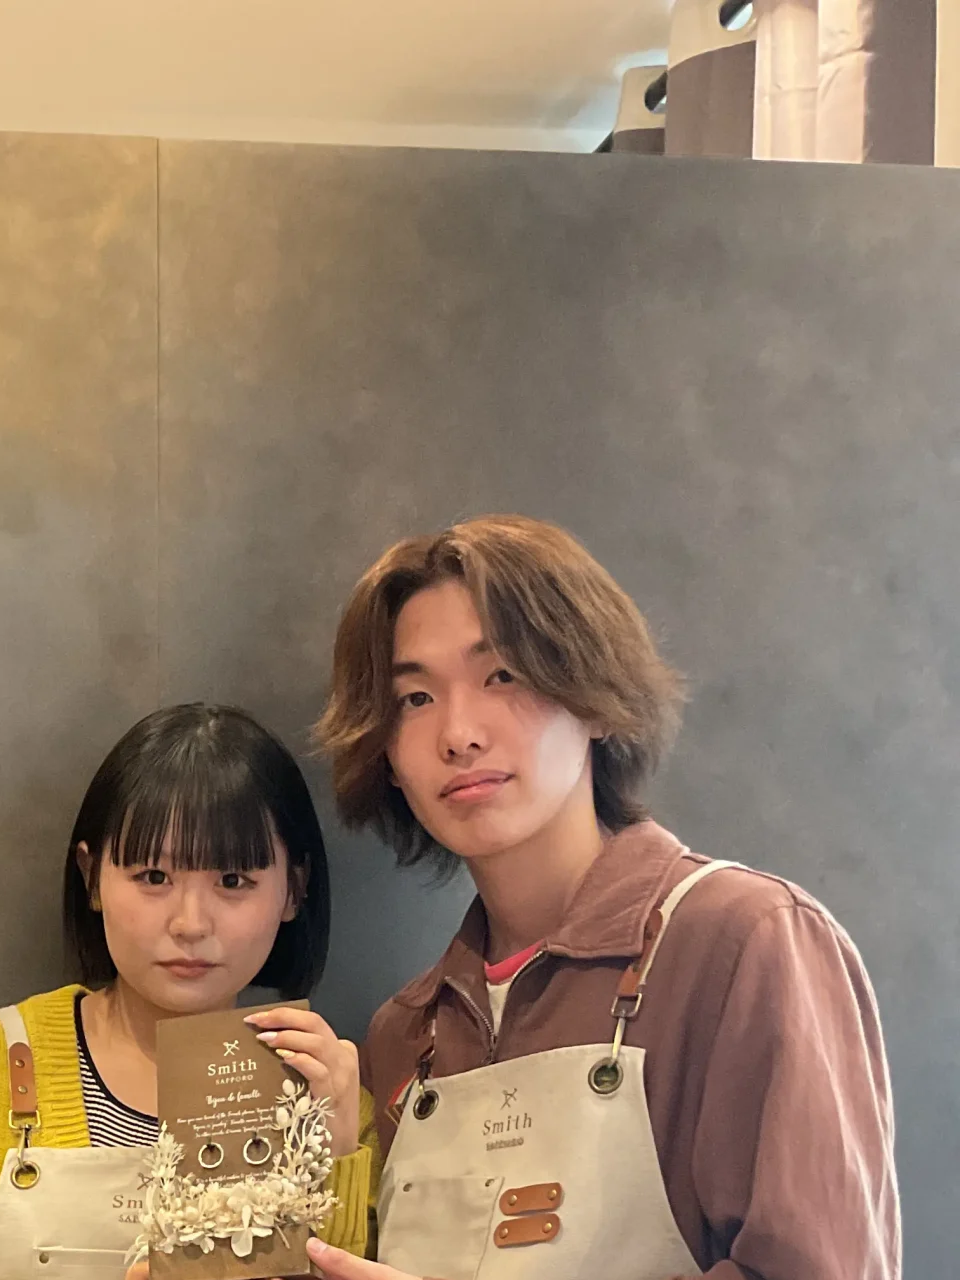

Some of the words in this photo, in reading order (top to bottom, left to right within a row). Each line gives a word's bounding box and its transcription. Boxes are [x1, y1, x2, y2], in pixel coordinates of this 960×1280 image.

[207, 1059, 257, 1076] Smith
[215, 1074, 253, 1085] SAPPORO
[482, 1113, 532, 1136] Smith
